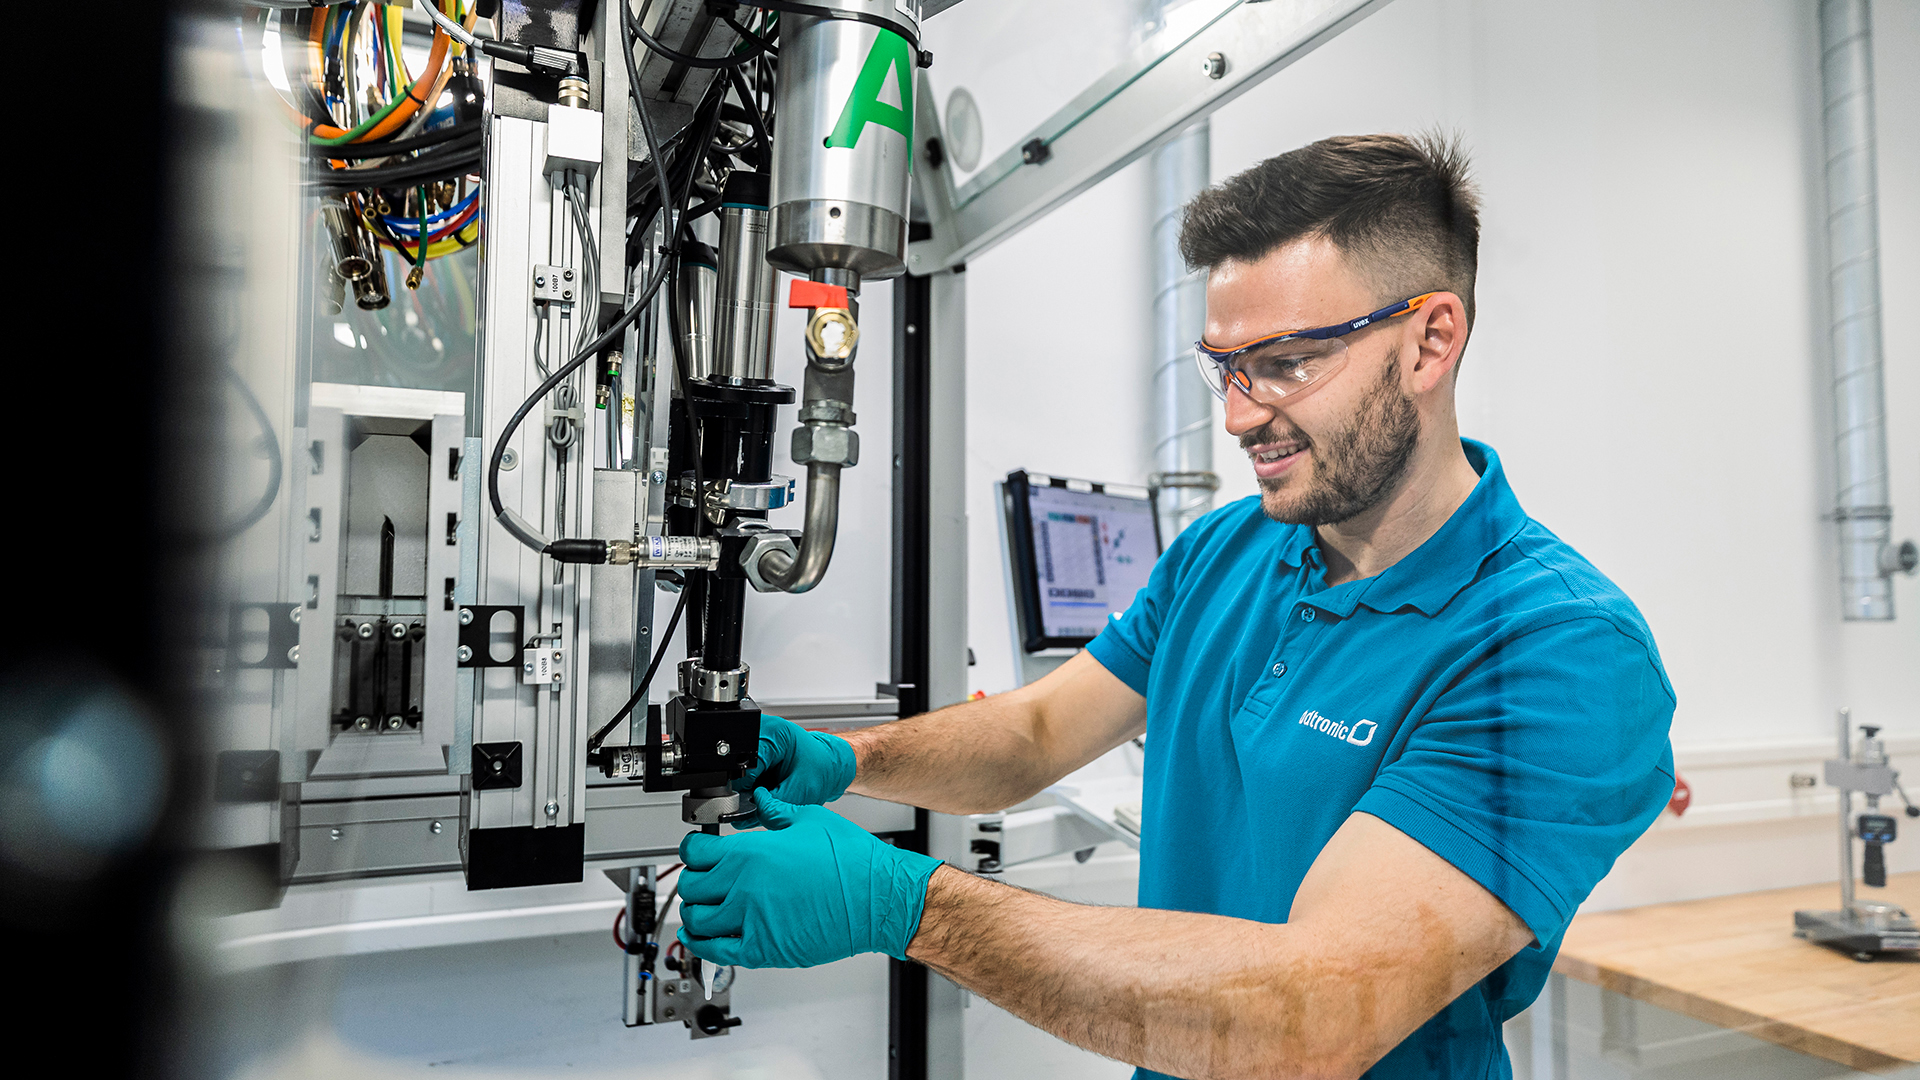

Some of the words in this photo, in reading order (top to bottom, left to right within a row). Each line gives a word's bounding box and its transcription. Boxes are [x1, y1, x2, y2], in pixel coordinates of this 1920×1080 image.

[825, 27, 914, 176] A
[1353, 317, 1370, 329] uvex
[653, 536, 661, 556] WIKA
